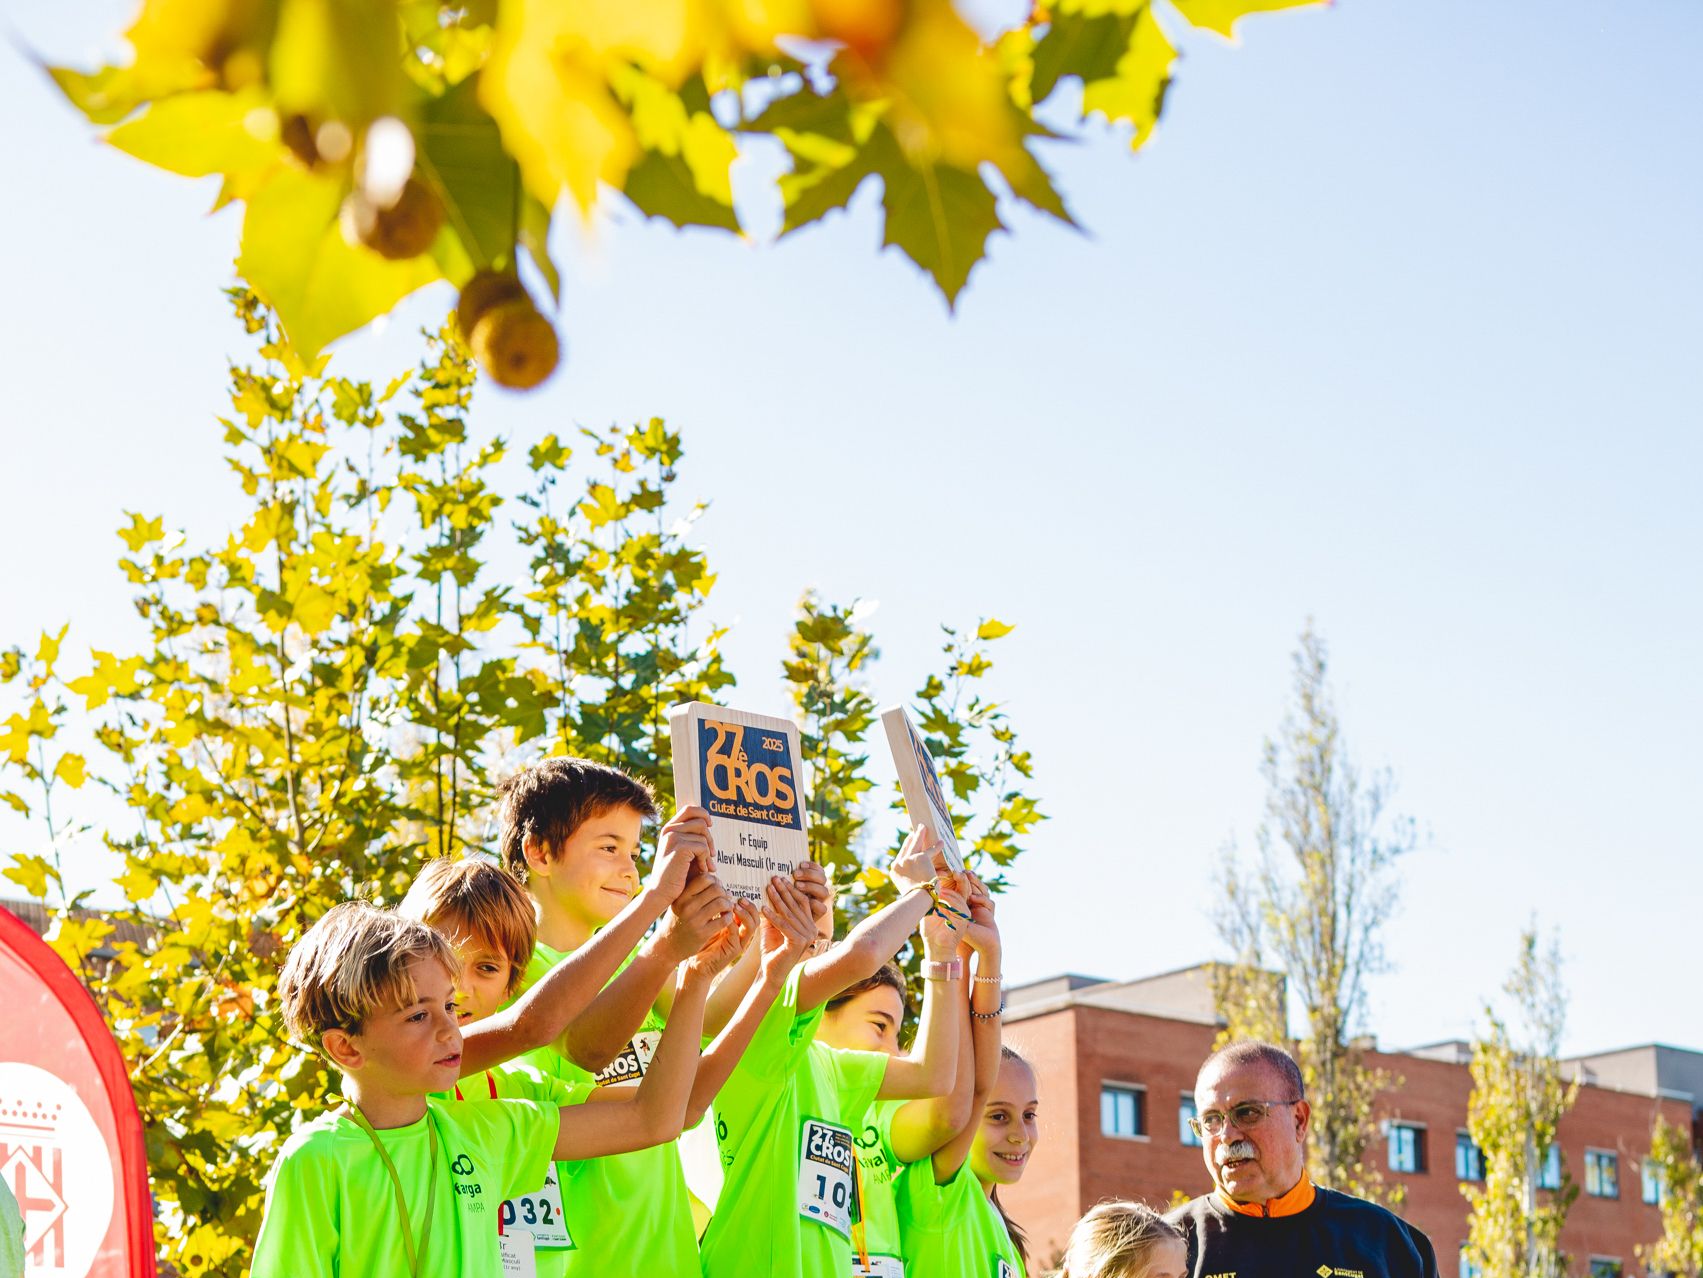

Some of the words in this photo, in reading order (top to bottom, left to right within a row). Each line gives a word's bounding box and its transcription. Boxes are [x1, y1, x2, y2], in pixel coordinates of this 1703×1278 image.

[762, 737, 784, 752] 2025
[705, 757, 795, 809] CROS
[709, 800, 736, 814] Ciutat
[736, 805, 748, 817] de
[748, 805, 768, 820] Sant
[769, 810, 793, 825] Cugat
[748, 834, 768, 851] Equip
[777, 860, 794, 875] any)
[810, 1139, 851, 1167] CROS
